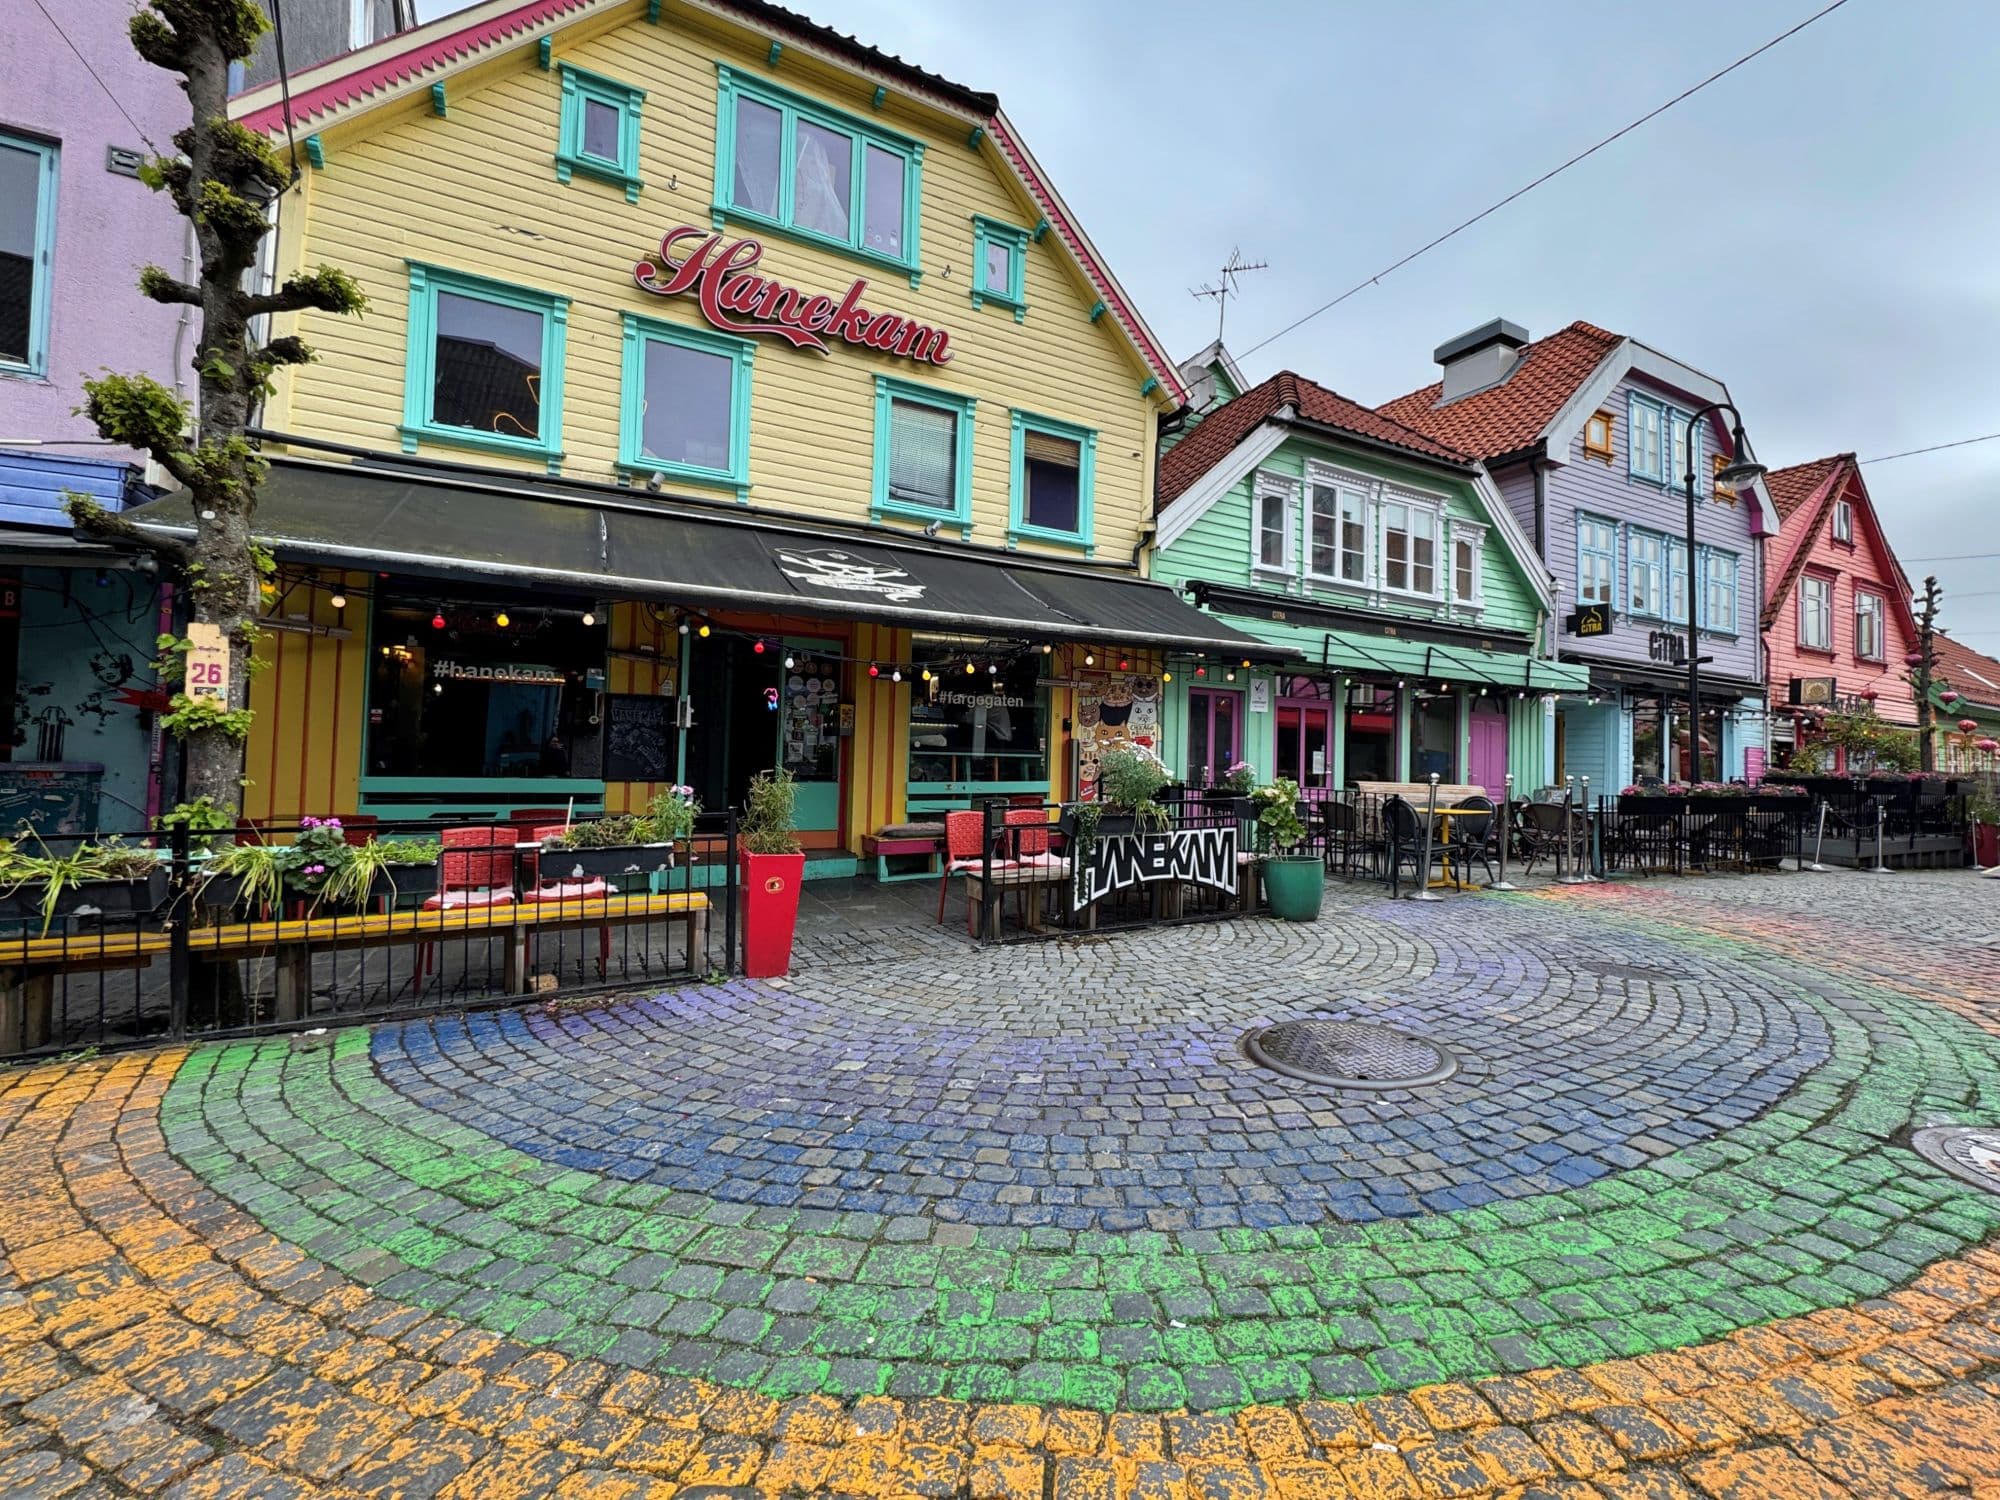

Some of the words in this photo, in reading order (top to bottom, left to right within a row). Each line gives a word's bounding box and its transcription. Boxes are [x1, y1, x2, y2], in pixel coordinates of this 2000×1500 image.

[633, 225, 955, 366] Hanekam
[191, 662, 222, 685] 26
[433, 660, 556, 681] #hanekam
[939, 690, 1025, 709] #fargegaten
[1074, 827, 1238, 912] HANEKAM
